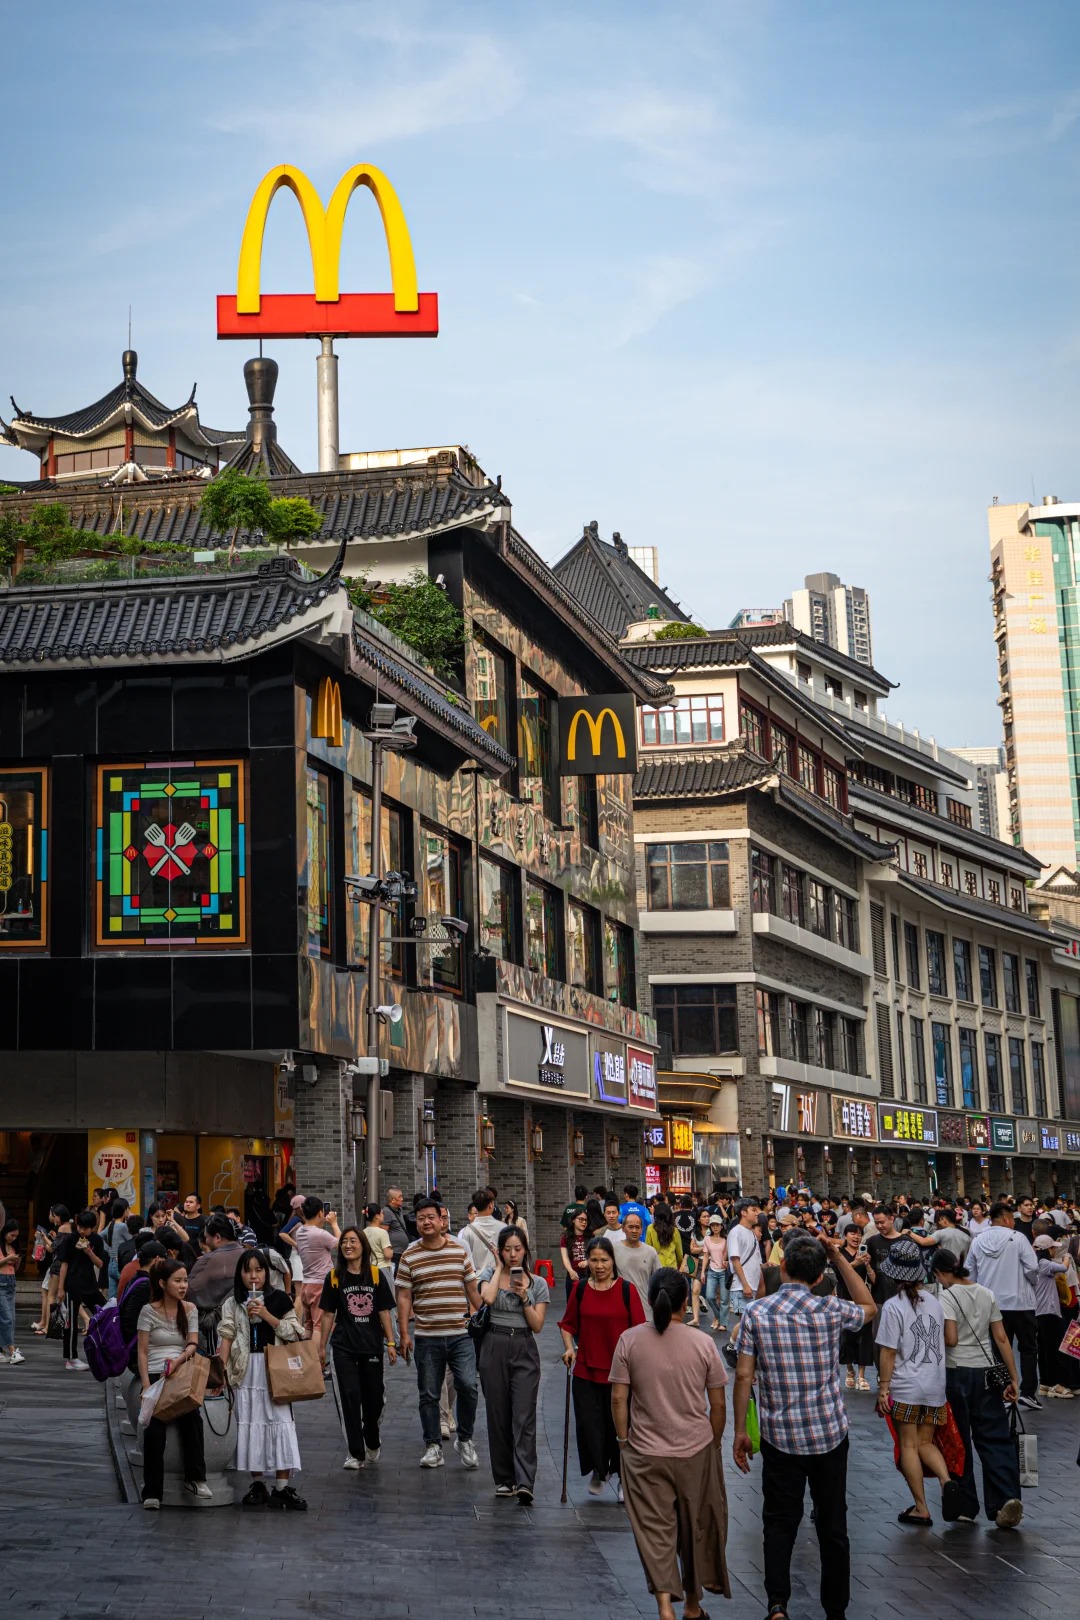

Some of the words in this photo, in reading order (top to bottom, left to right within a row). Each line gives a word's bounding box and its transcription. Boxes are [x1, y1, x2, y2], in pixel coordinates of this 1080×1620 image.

[1025, 547, 1046, 633] 华佳广场
[843, 1100, 872, 1137] 中国黄金
[98, 1158, 128, 1178] ¥7.50
